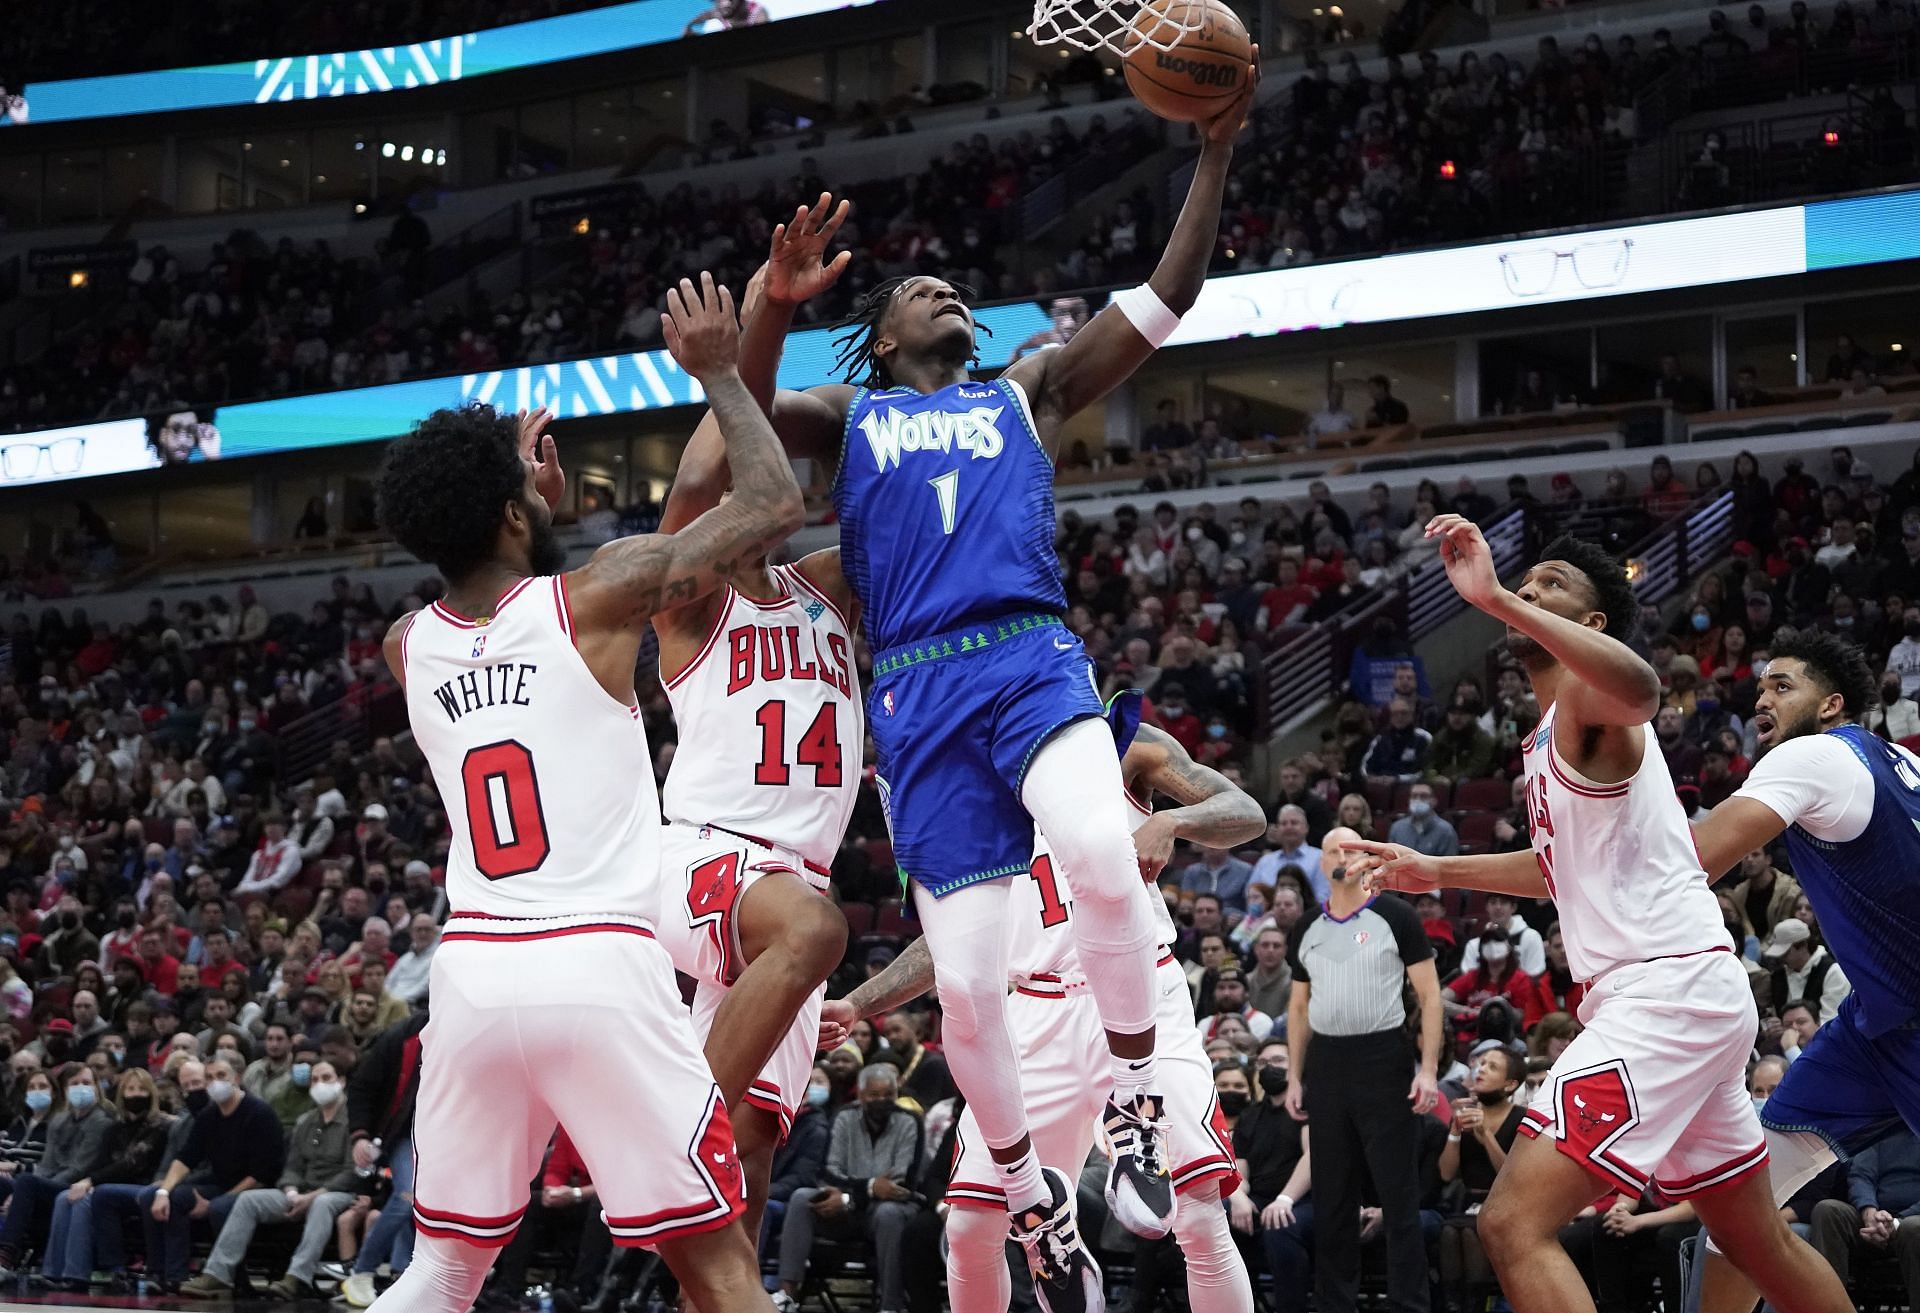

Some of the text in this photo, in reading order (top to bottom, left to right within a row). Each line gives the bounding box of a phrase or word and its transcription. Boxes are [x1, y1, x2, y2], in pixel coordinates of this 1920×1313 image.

[1155, 51, 1238, 88] Wilson
[857, 405, 1005, 474] WOLVES
[927, 468, 960, 535] 1
[433, 663, 537, 723] WHITE
[727, 624, 851, 701] BULLS
[754, 699, 843, 788] 14
[461, 738, 551, 881] 0
[1029, 853, 1073, 929] 1
